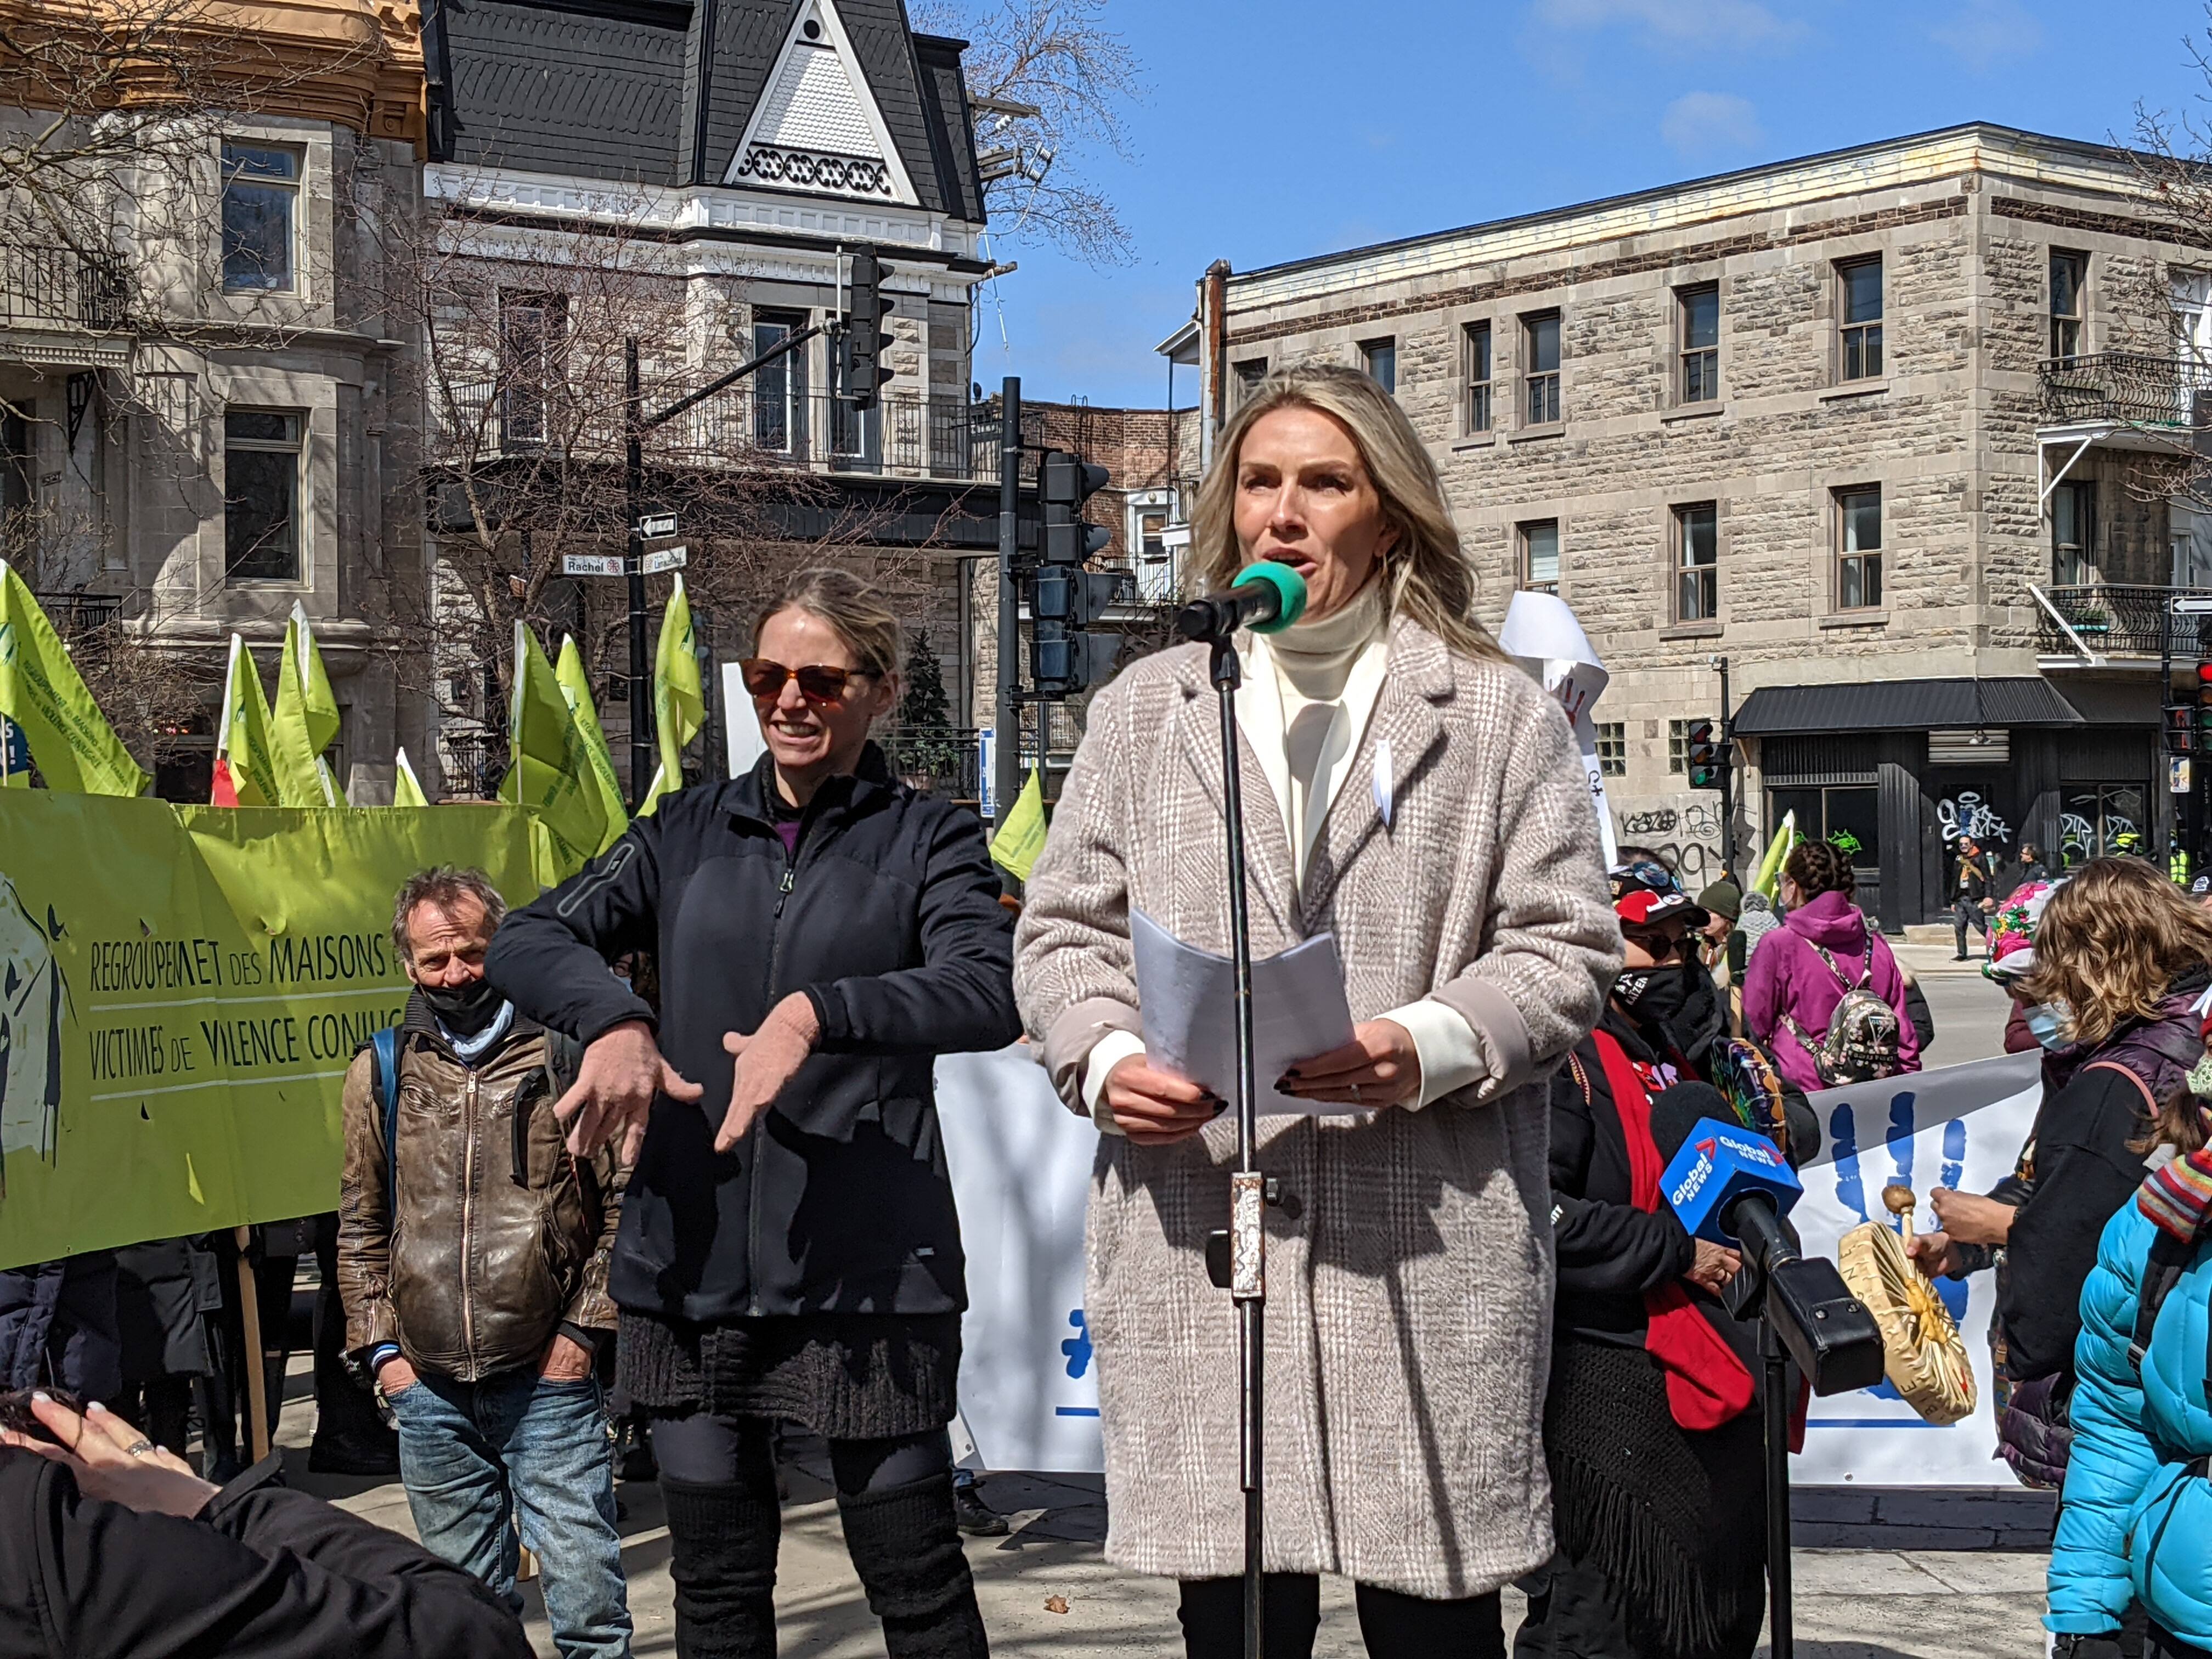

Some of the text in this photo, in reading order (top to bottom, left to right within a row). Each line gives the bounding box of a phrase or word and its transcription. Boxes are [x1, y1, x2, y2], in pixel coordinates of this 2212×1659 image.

[568, 561, 603, 572] Rachel
[229, 952, 262, 985] DES
[269, 933, 385, 983] MAISONS
[171, 1037, 195, 1072] DE
[1719, 1135, 1771, 1160] Global
[1673, 1153, 1708, 1206] Global
[1686, 1163, 1713, 1203] NEWS
